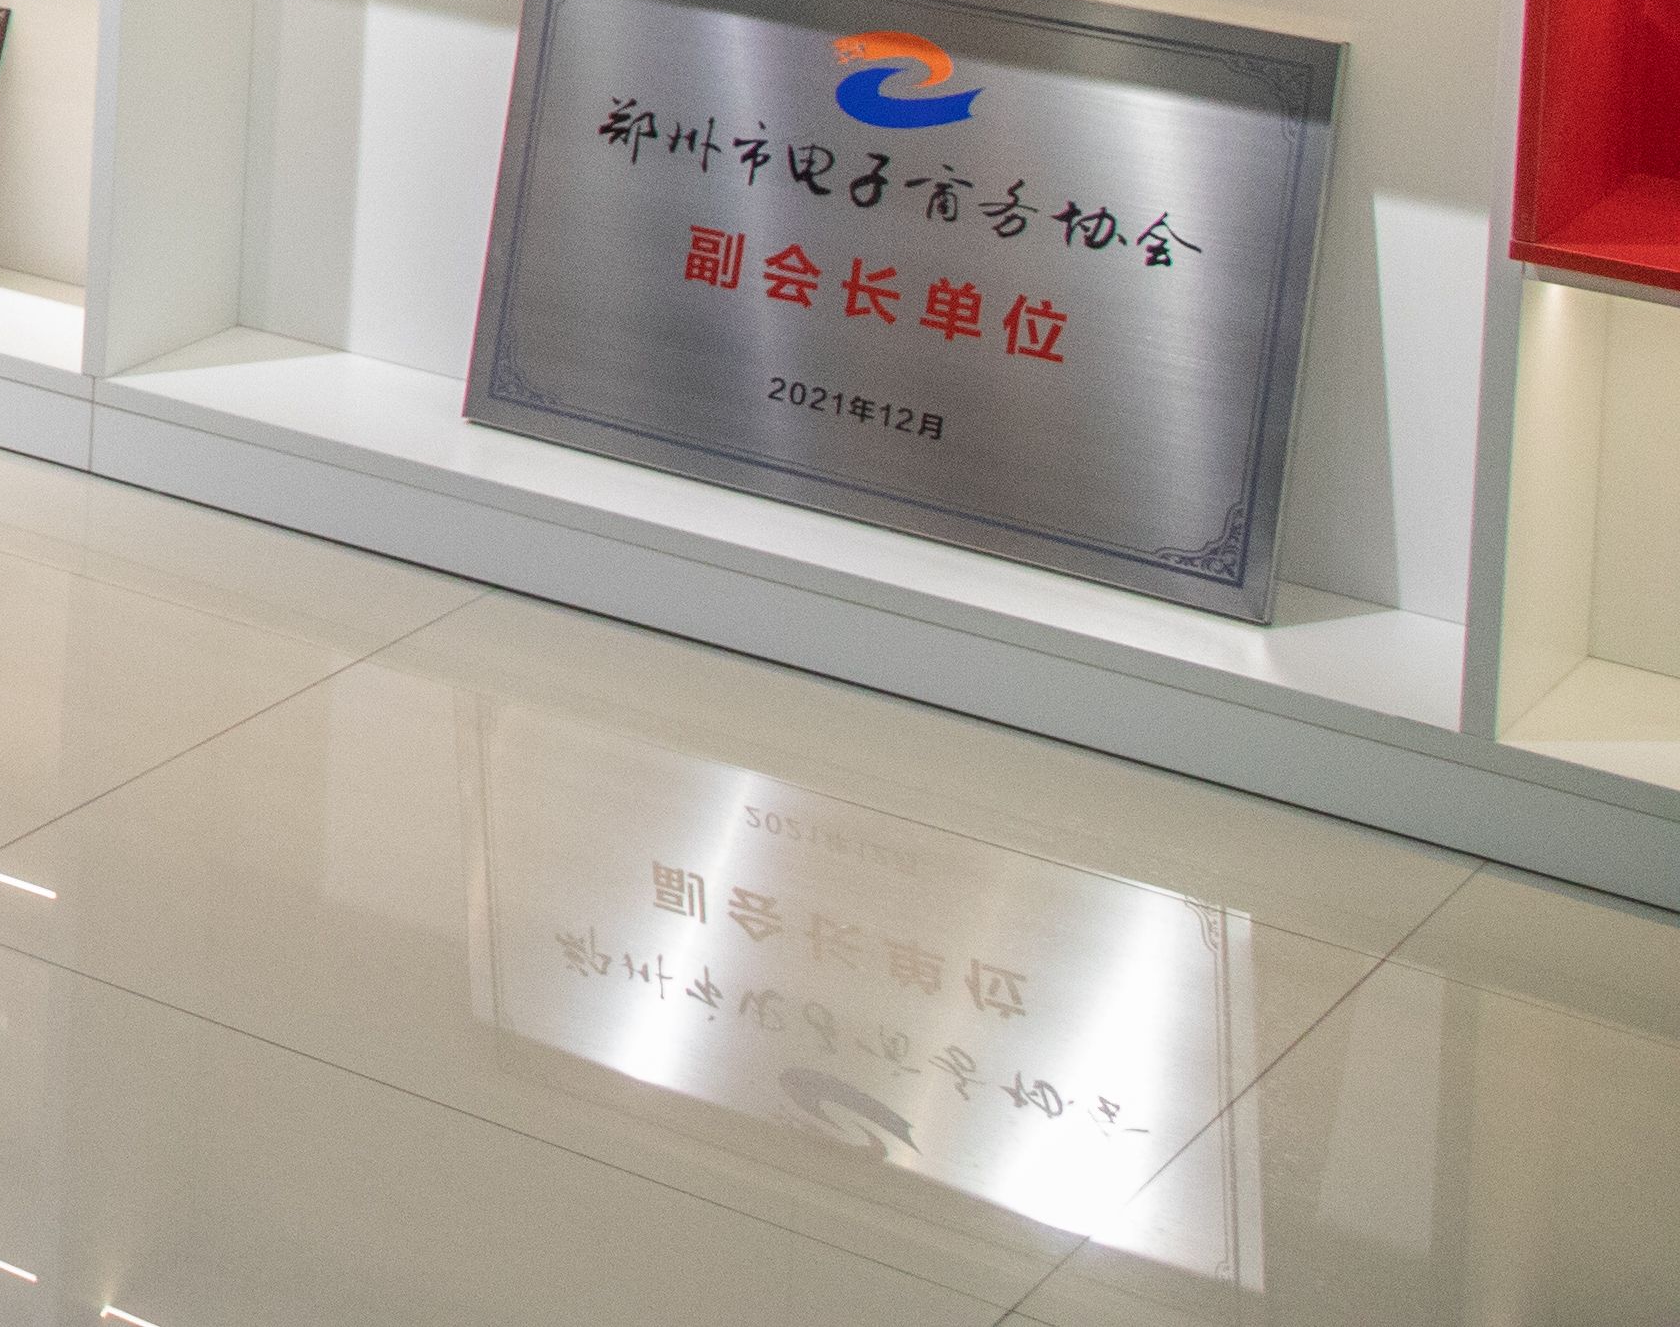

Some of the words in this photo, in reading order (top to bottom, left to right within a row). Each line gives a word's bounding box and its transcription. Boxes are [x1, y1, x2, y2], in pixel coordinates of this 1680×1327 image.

[596, 97, 1204, 271] 郑州市电子商务协会
[683, 224, 1069, 364] 副会长单位
[767, 376, 945, 443] 2021年12月
